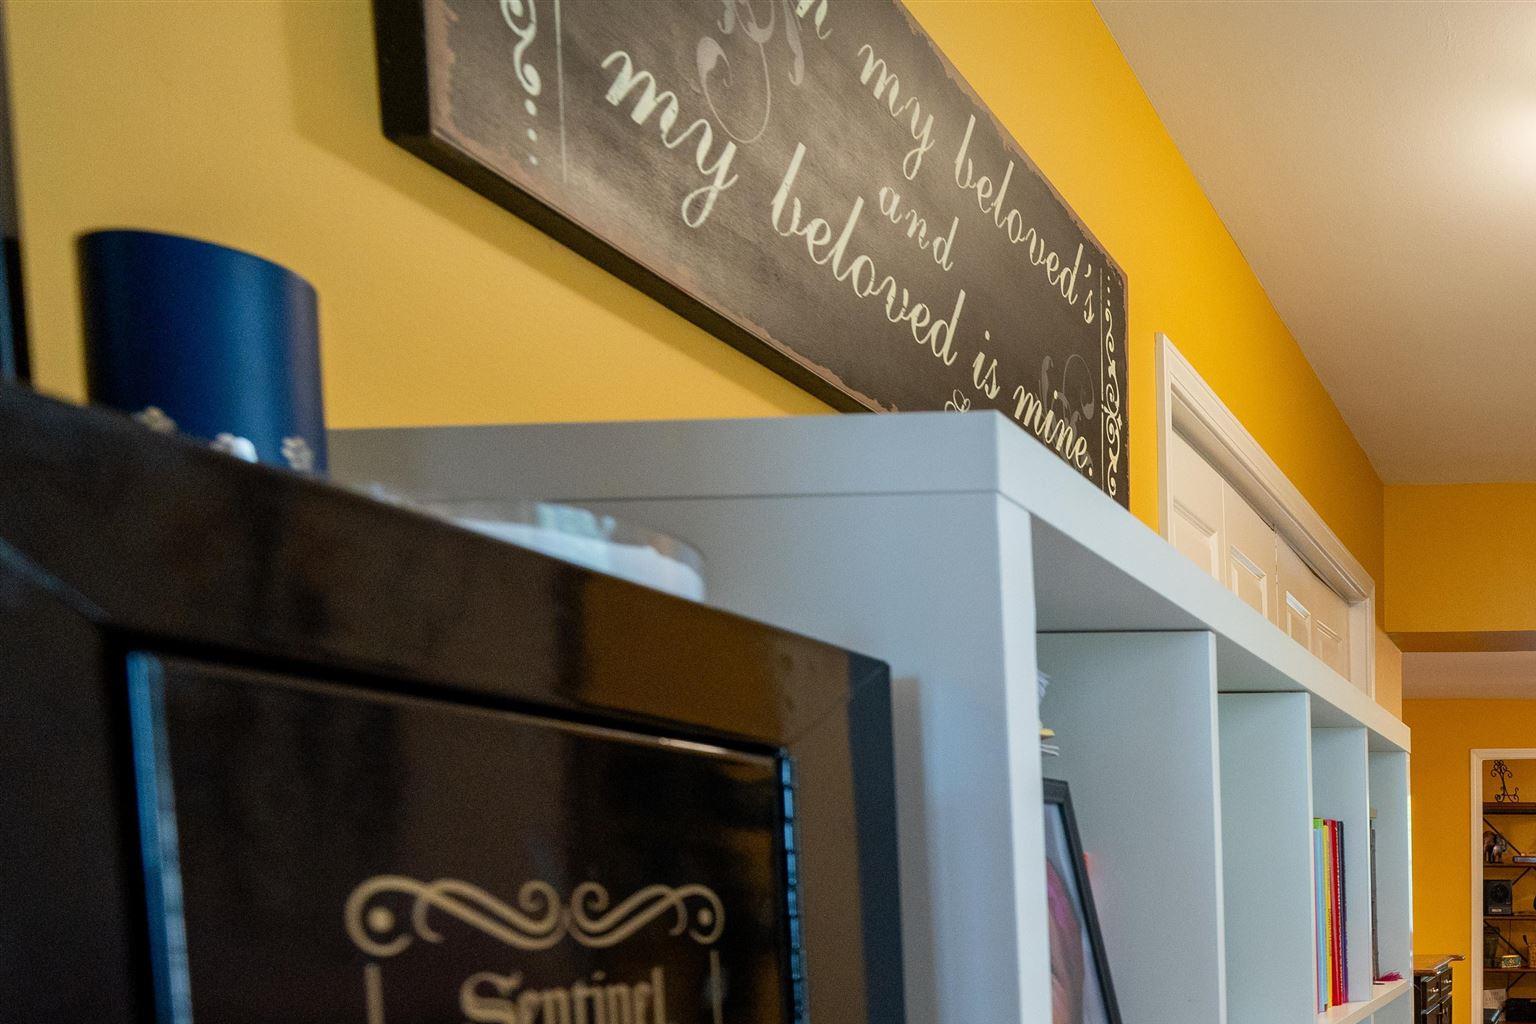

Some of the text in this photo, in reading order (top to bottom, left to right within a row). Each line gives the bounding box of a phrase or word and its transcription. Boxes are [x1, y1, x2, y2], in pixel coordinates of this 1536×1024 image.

[601, 50, 739, 228] my
[771, 142, 966, 366] beloved
[972, 330, 1000, 400] is
[858, 44, 1094, 324] my beloved's
[879, 186, 959, 271] and
